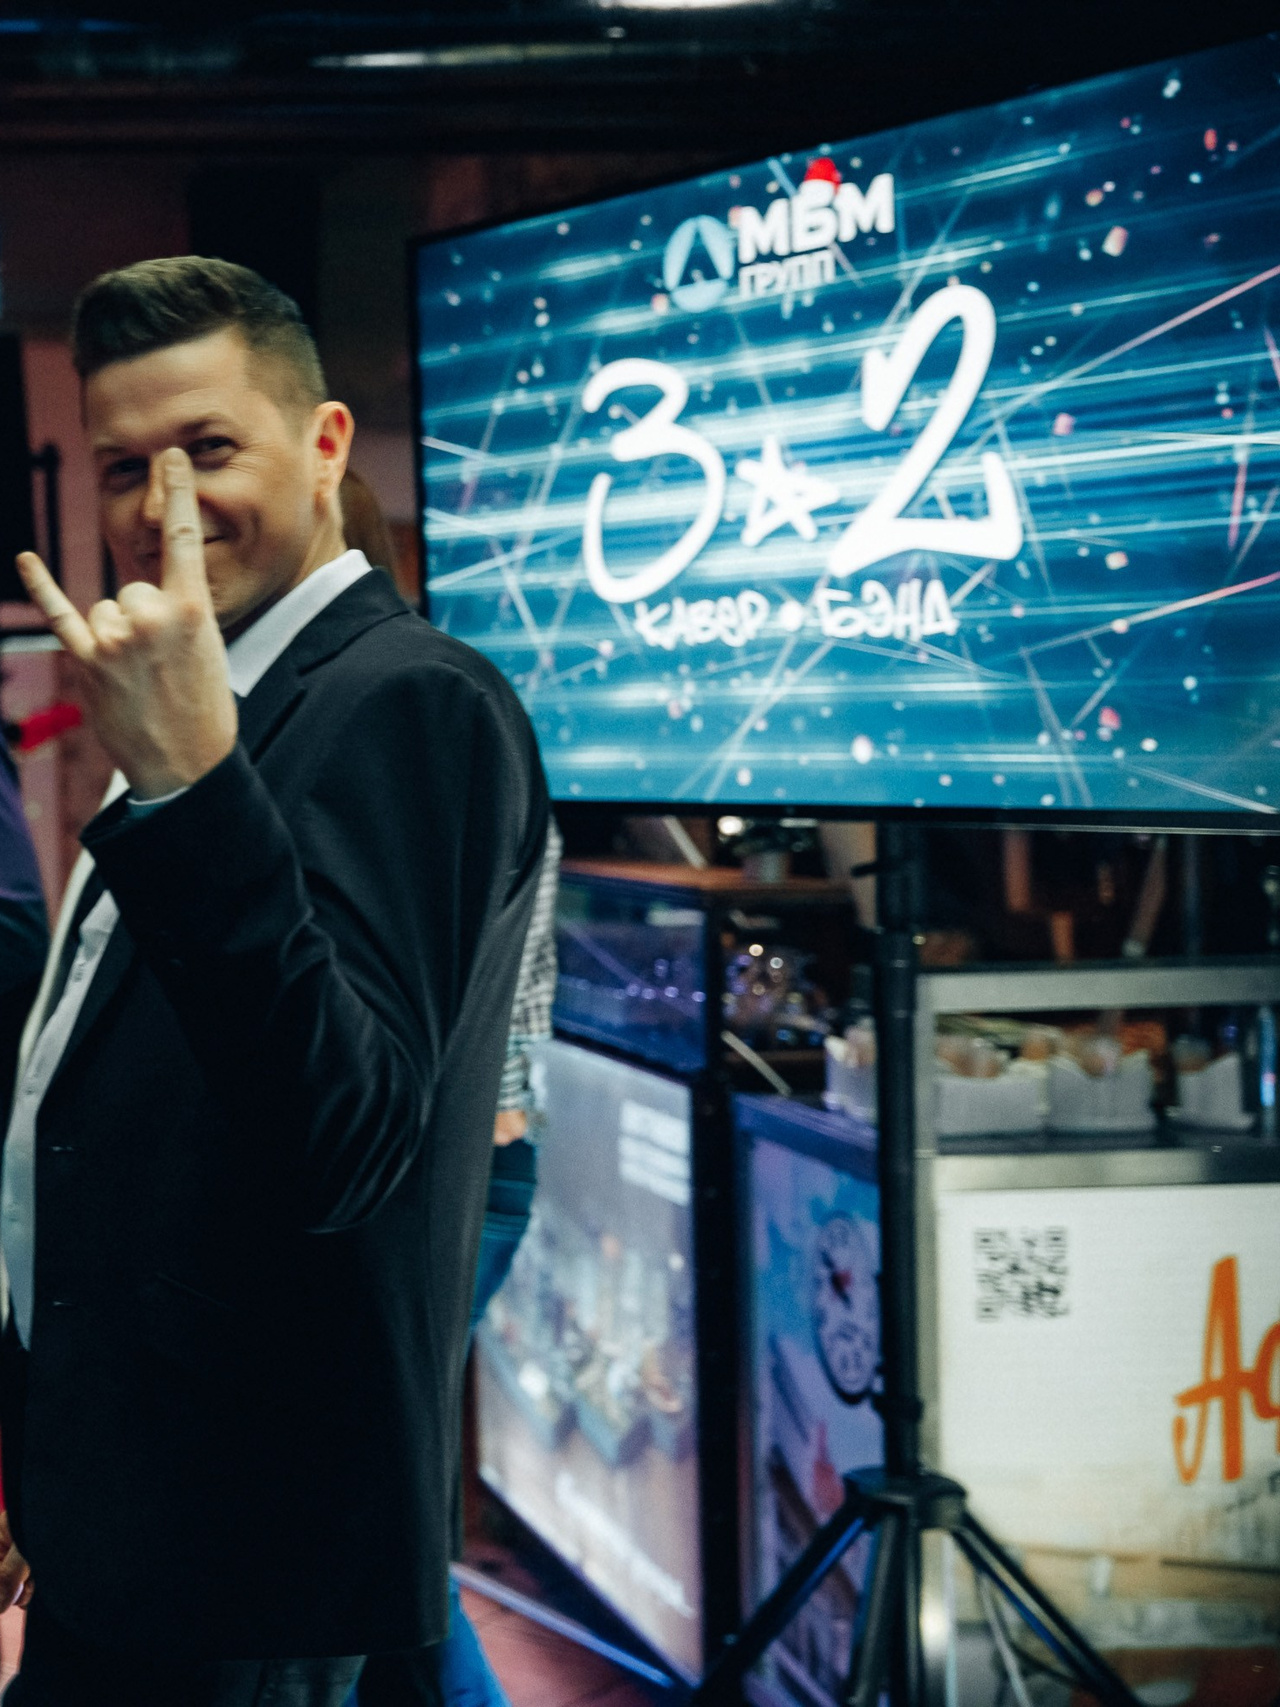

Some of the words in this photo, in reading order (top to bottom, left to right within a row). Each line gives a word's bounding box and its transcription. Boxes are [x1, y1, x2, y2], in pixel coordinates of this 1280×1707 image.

[738, 173, 895, 264] МБМ
[738, 250, 836, 300] ГРУПП
[818, 577, 960, 643] БЭНД
